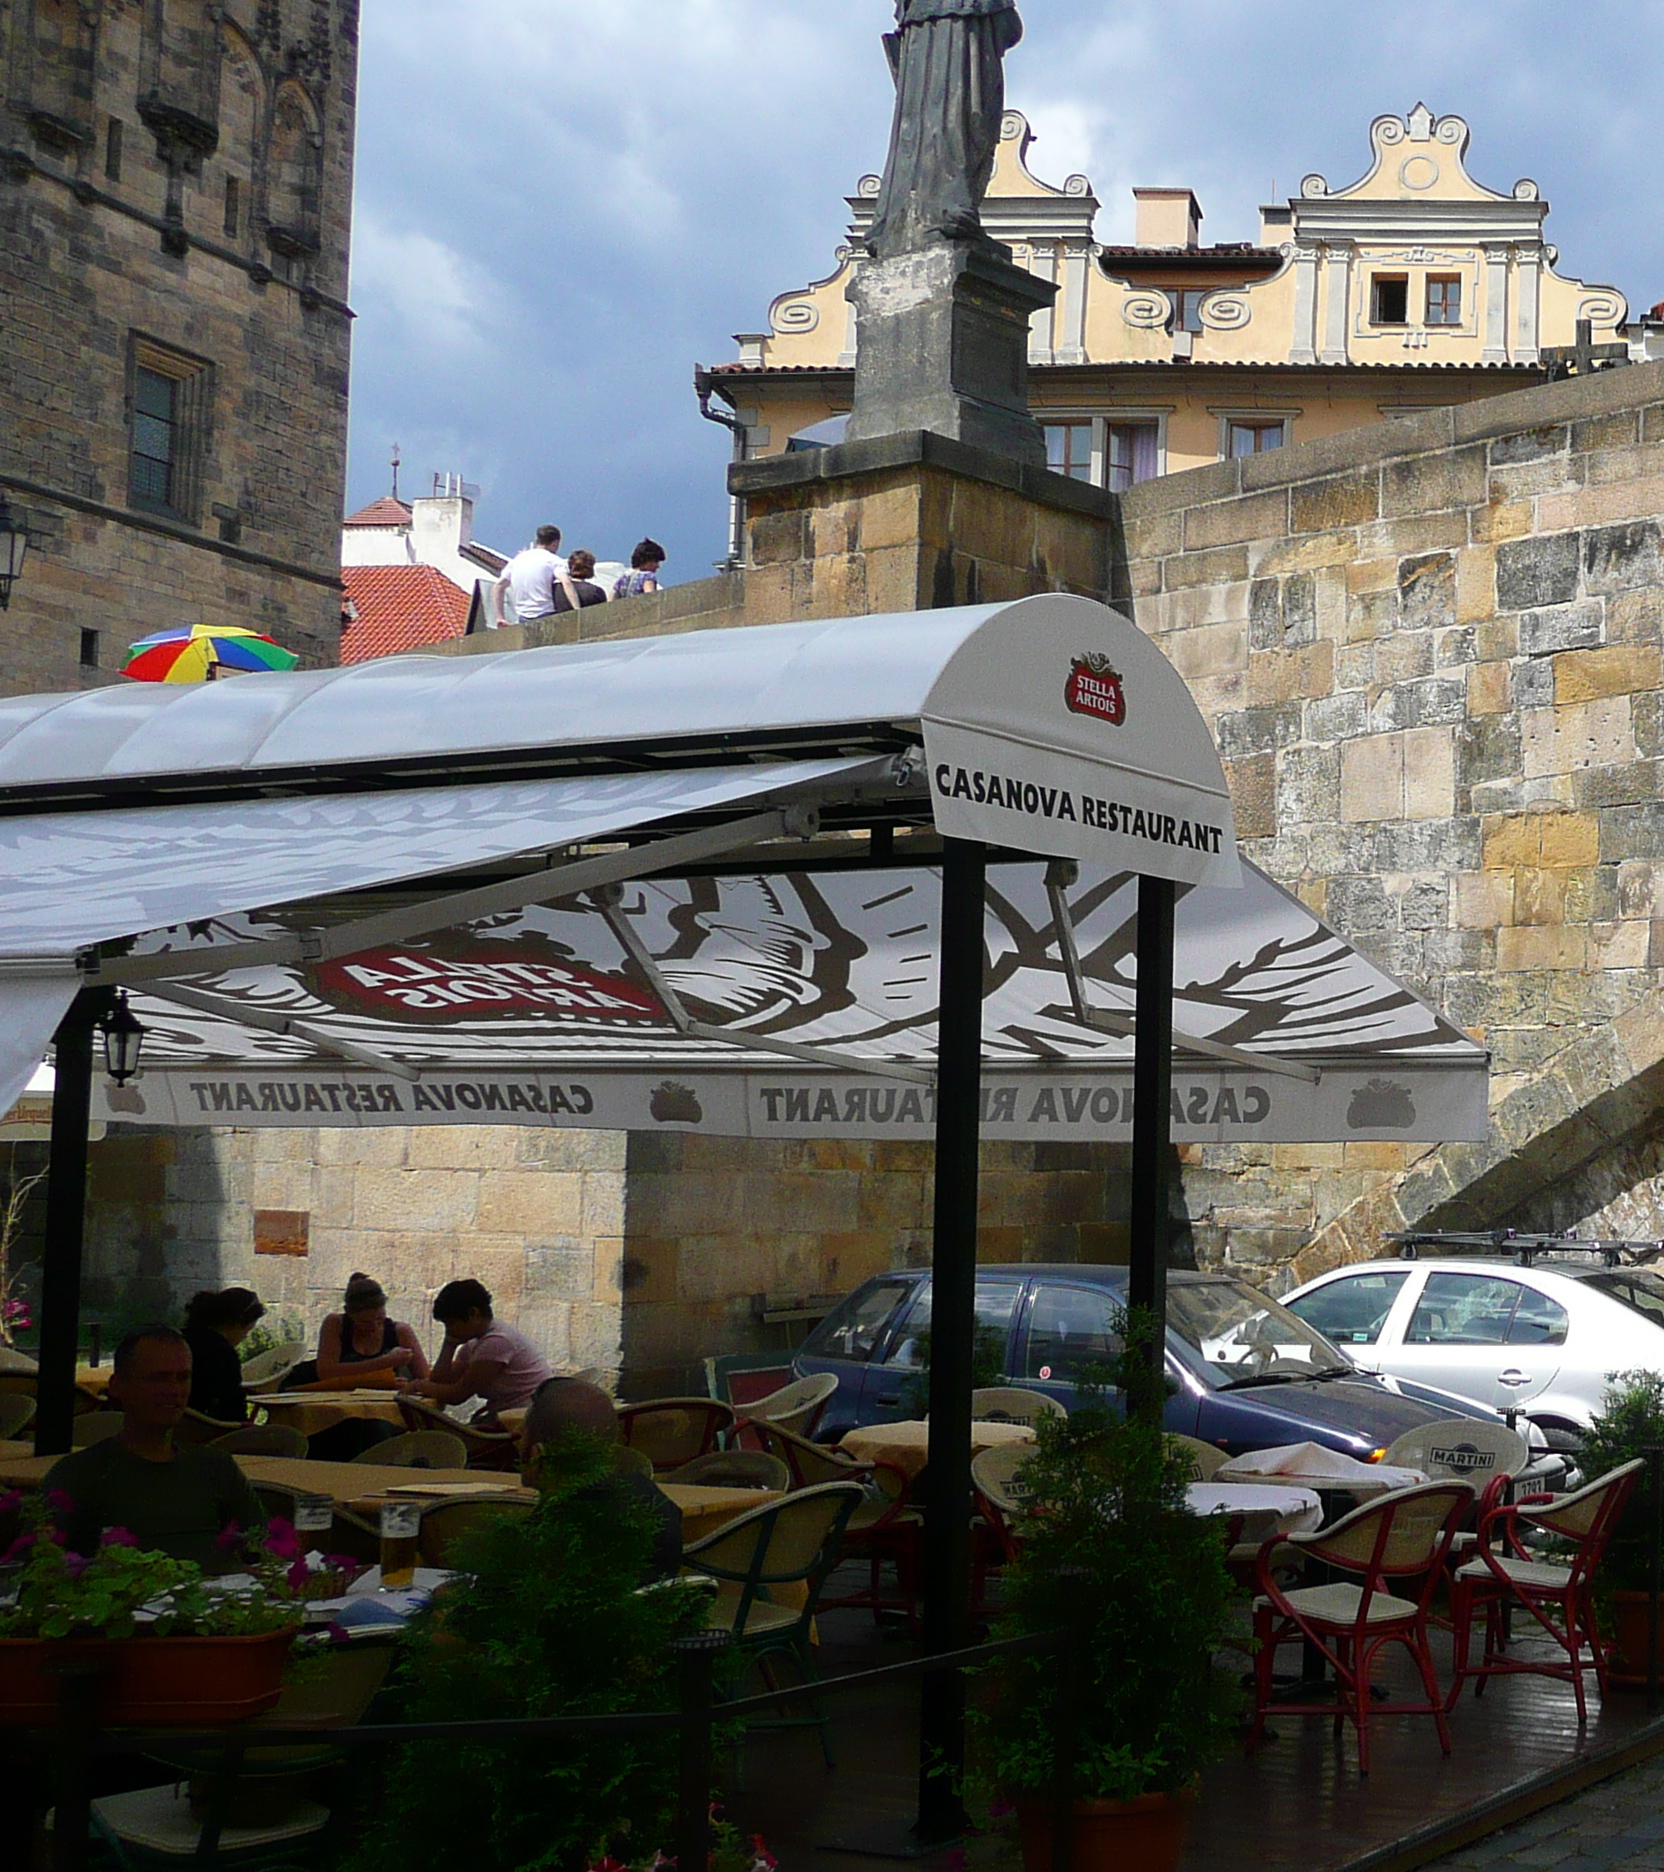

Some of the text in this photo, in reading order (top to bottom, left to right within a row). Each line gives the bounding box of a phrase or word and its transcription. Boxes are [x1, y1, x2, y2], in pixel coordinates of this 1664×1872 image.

[1077, 675, 1115, 699] STELLA
[1076, 690, 1116, 714] ARTOIS
[935, 764, 1223, 854] CASANOVA RESTAURANT
[1433, 1451, 1492, 1466] MARTINI
